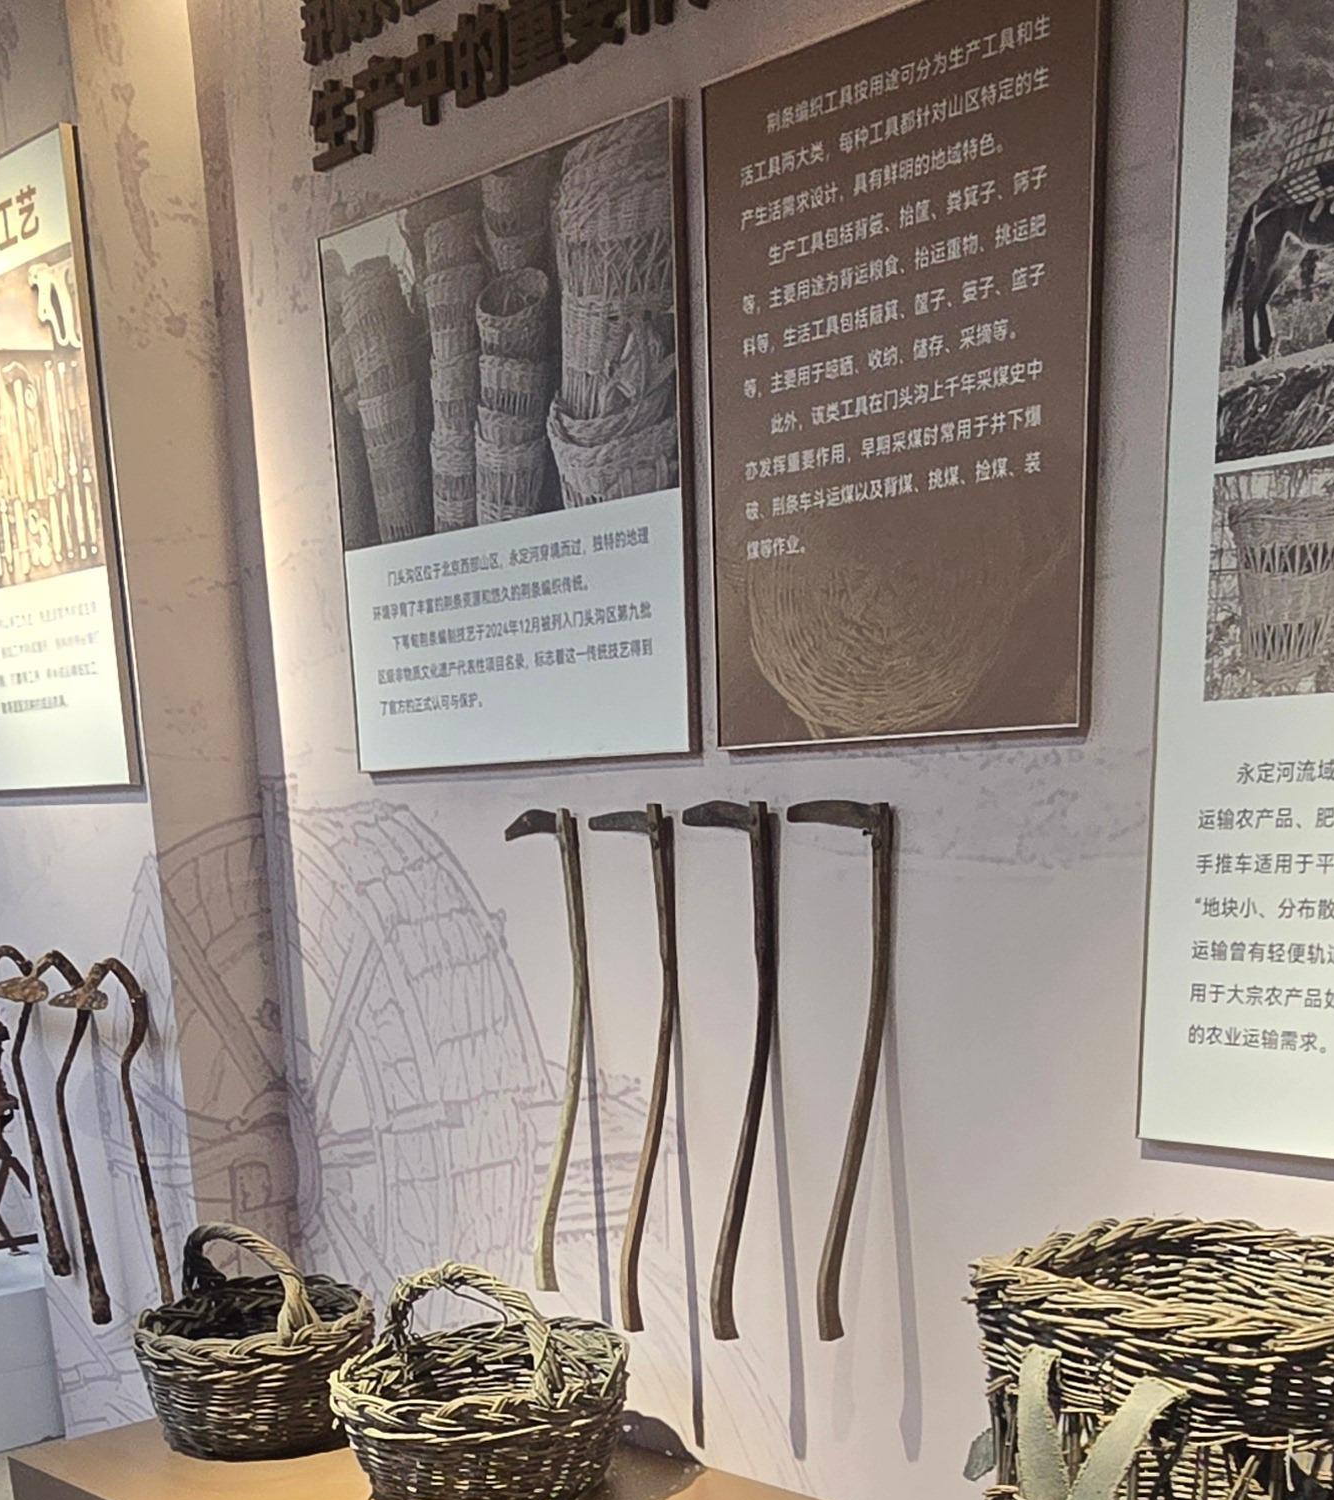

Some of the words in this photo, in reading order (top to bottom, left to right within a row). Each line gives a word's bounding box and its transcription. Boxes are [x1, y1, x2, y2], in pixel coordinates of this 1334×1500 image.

[311, 0, 710, 172] 生产中的重要
[767, 14, 1050, 134] 荆条编织工具按用途可分为生产工具和生
[740, 66, 1049, 188] 活工具两大类，每种工具都针对山区特定的生
[740, 133, 1003, 231] 产生活需求设计，具有鲜明的地域特色。
[742, 214, 1046, 315] 等，主要用途为背运粮食、抬运重物、挑运肥
[745, 405, 1042, 480] 亦发挥重要作用，早期采煤时常用于井下爆
[770, 358, 1043, 434] 此外，该类工具在门头沟上千年采煤史中
[746, 535, 805, 560] 煤等作业。
[1187, 1025, 1328, 1054] 的农业运输需求。
